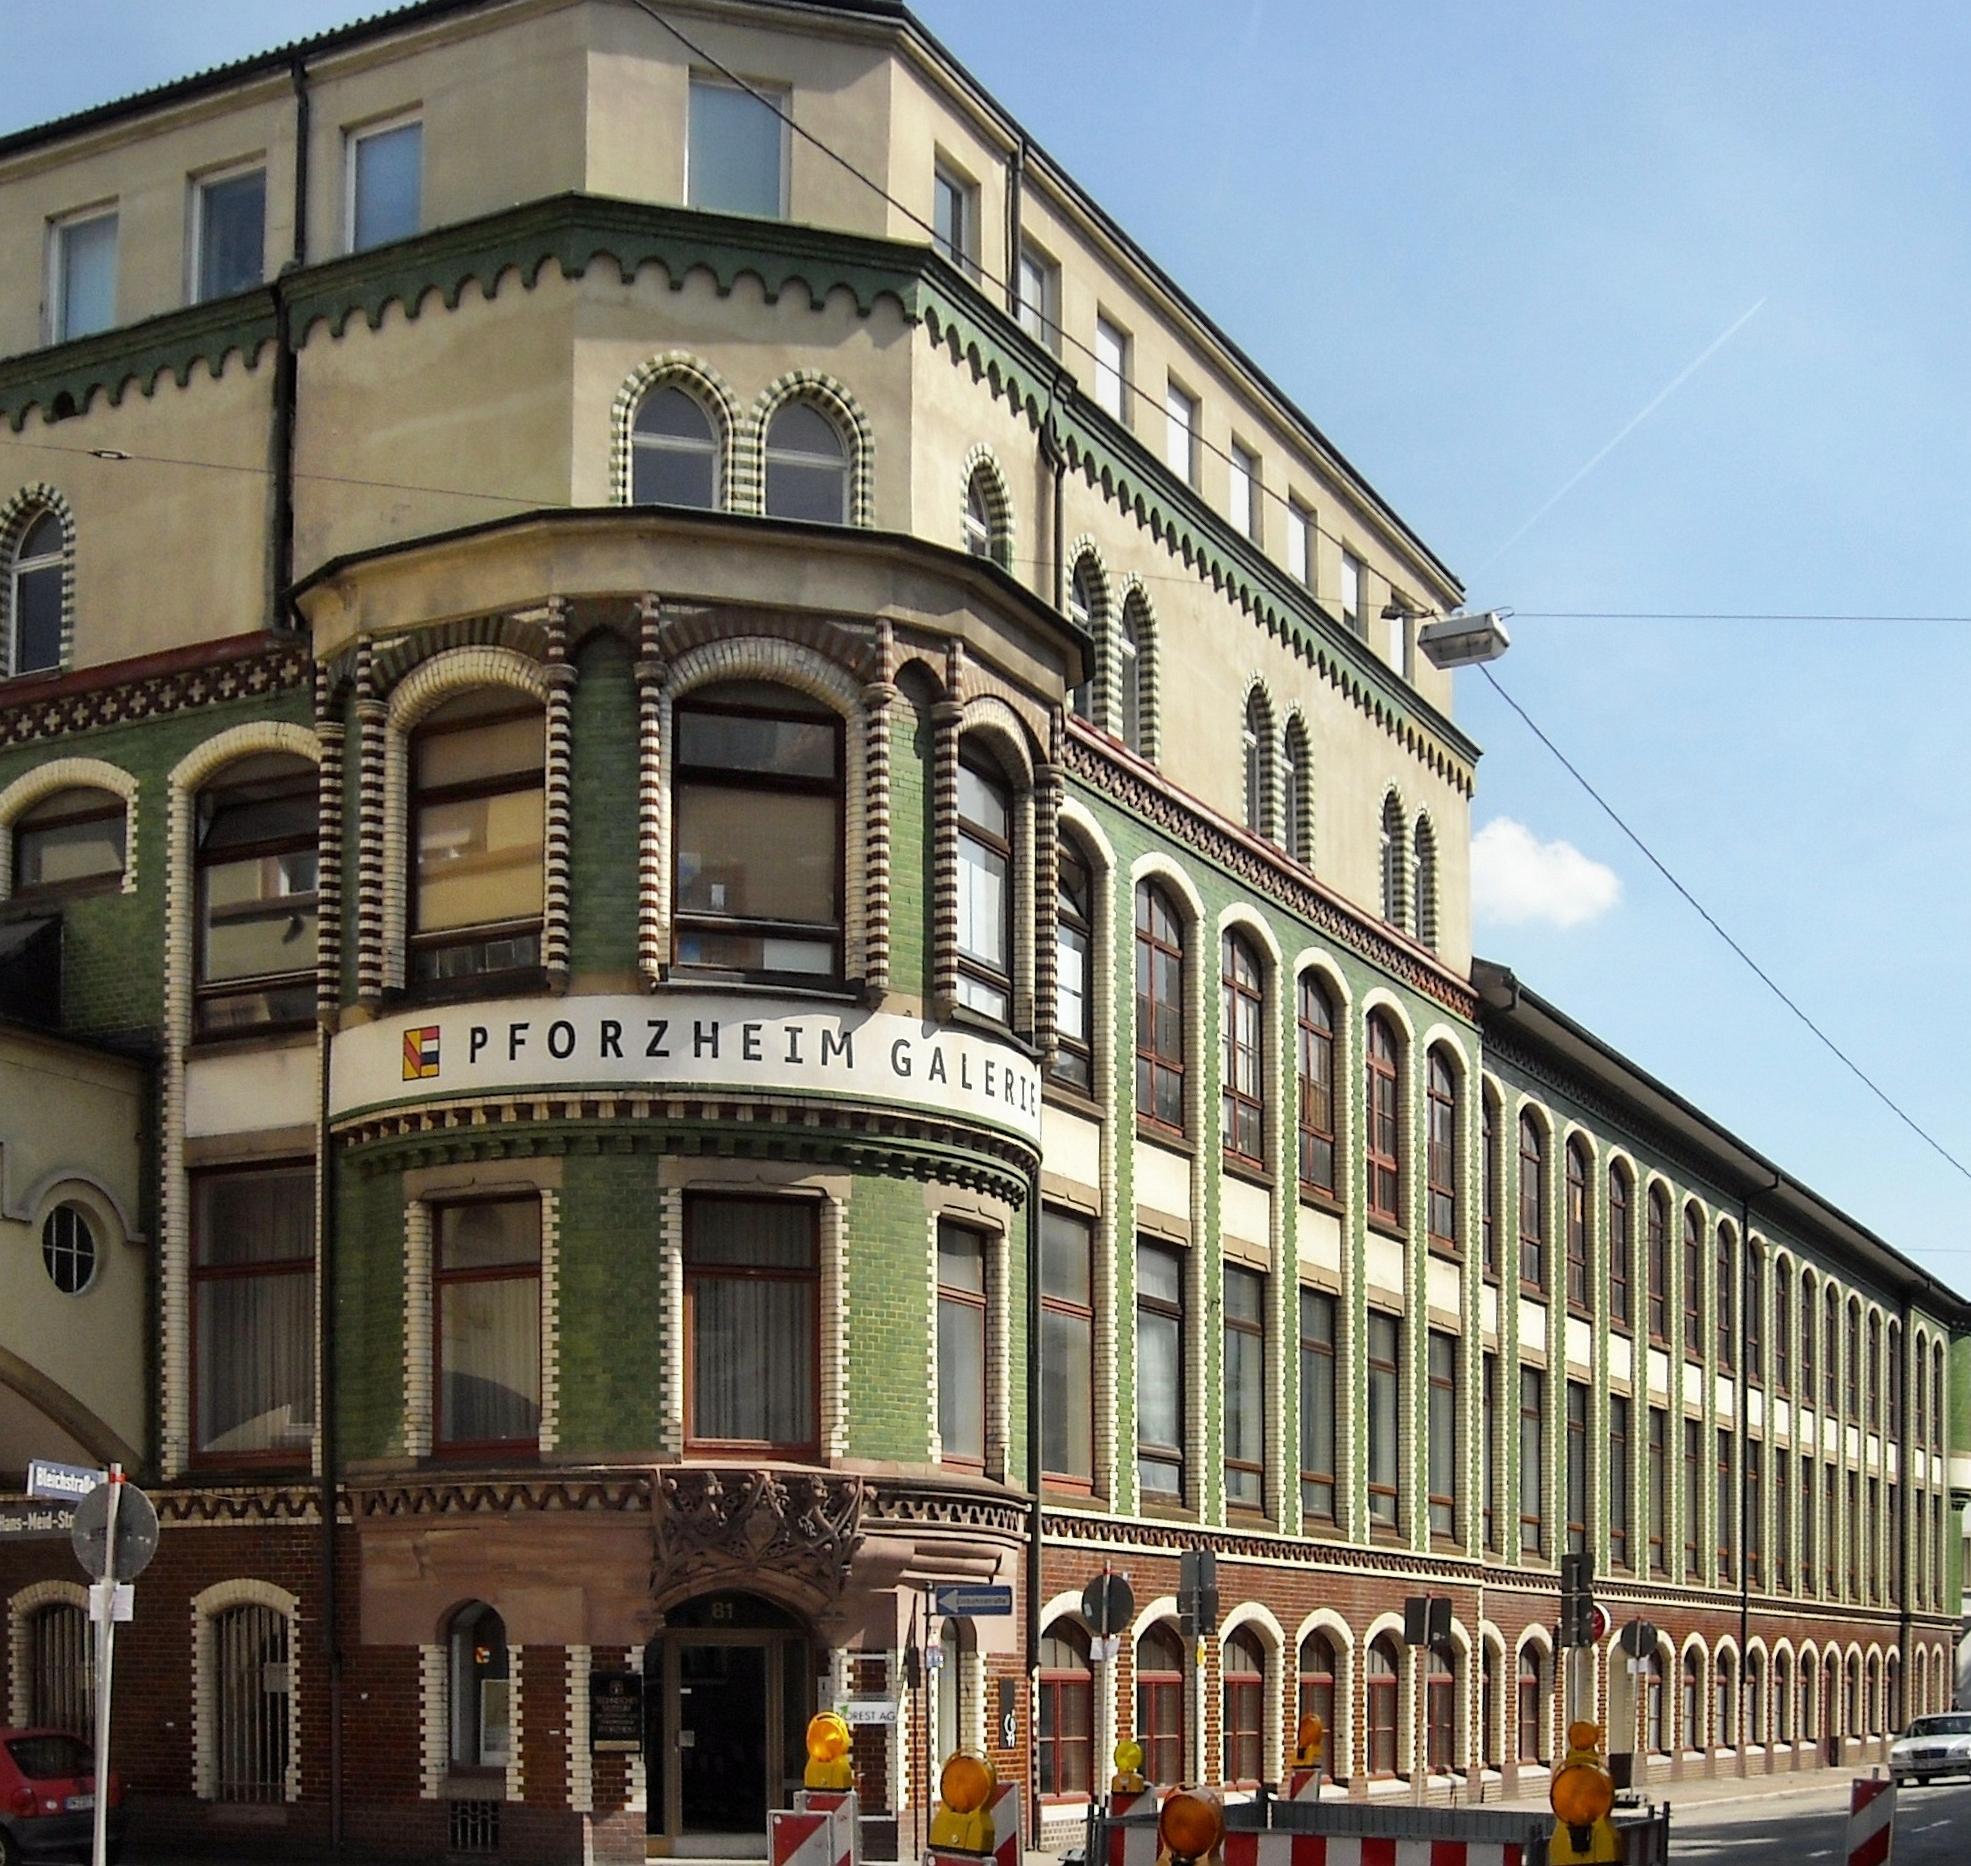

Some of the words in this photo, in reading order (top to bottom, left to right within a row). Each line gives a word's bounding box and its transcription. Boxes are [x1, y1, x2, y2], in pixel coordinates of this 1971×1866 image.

[470, 1020, 853, 1068] PFORZHEIM
[890, 1039, 1036, 1118] GALERIE
[37, 1467, 96, 1494] Bleichstraße
[711, 1602, 733, 1619] 81
[880, 1711, 896, 1721] AG
